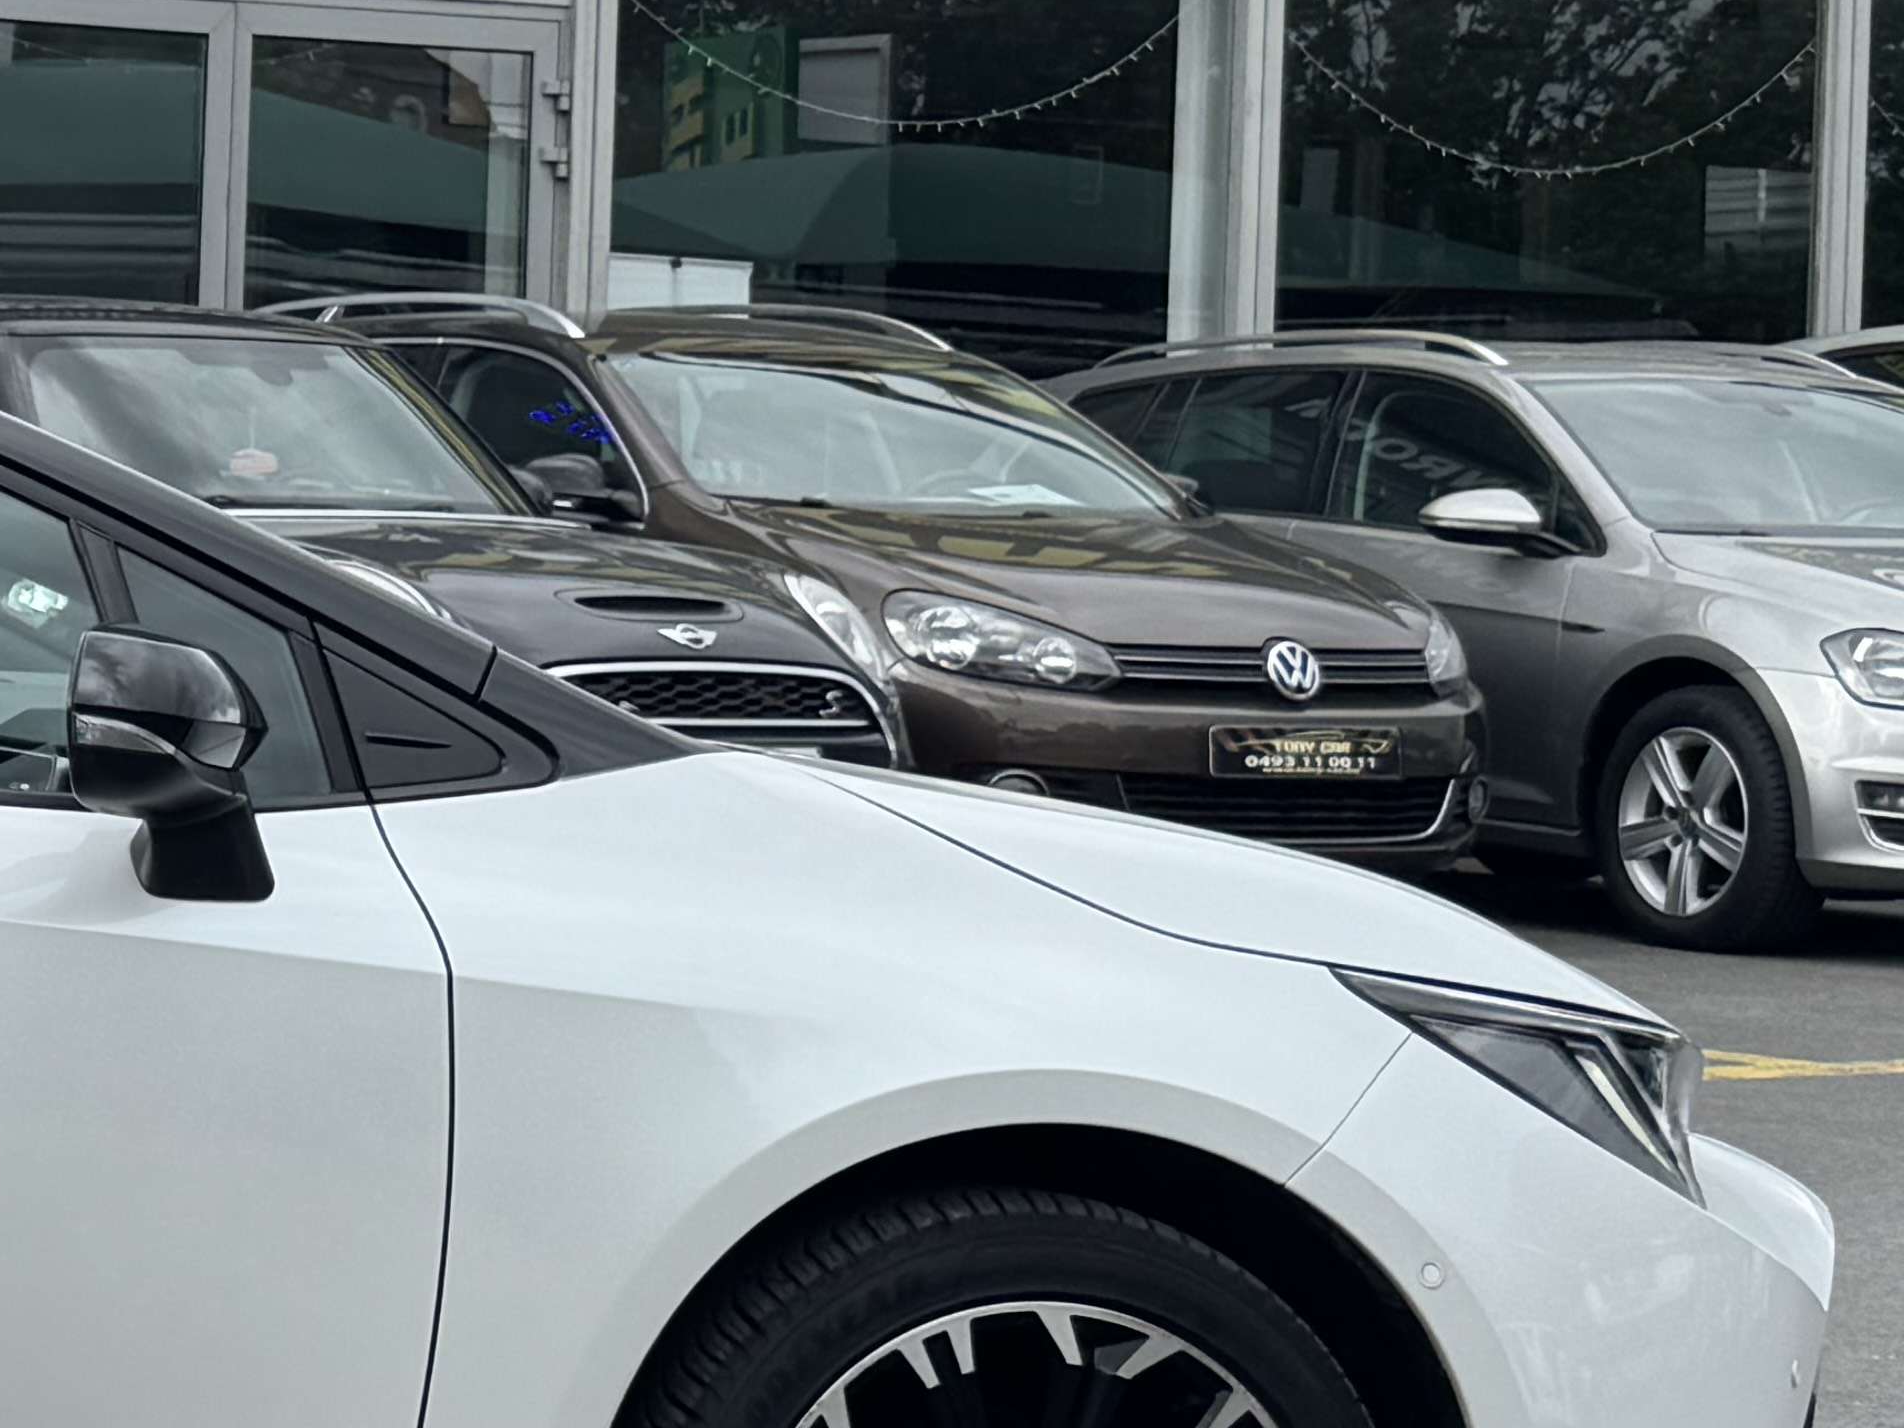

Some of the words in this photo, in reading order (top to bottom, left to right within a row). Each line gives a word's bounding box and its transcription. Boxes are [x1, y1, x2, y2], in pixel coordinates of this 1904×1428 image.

[1244, 754, 1295, 768] 0493
[1303, 755, 1323, 768] 11
[1357, 756, 1376, 770] 11
